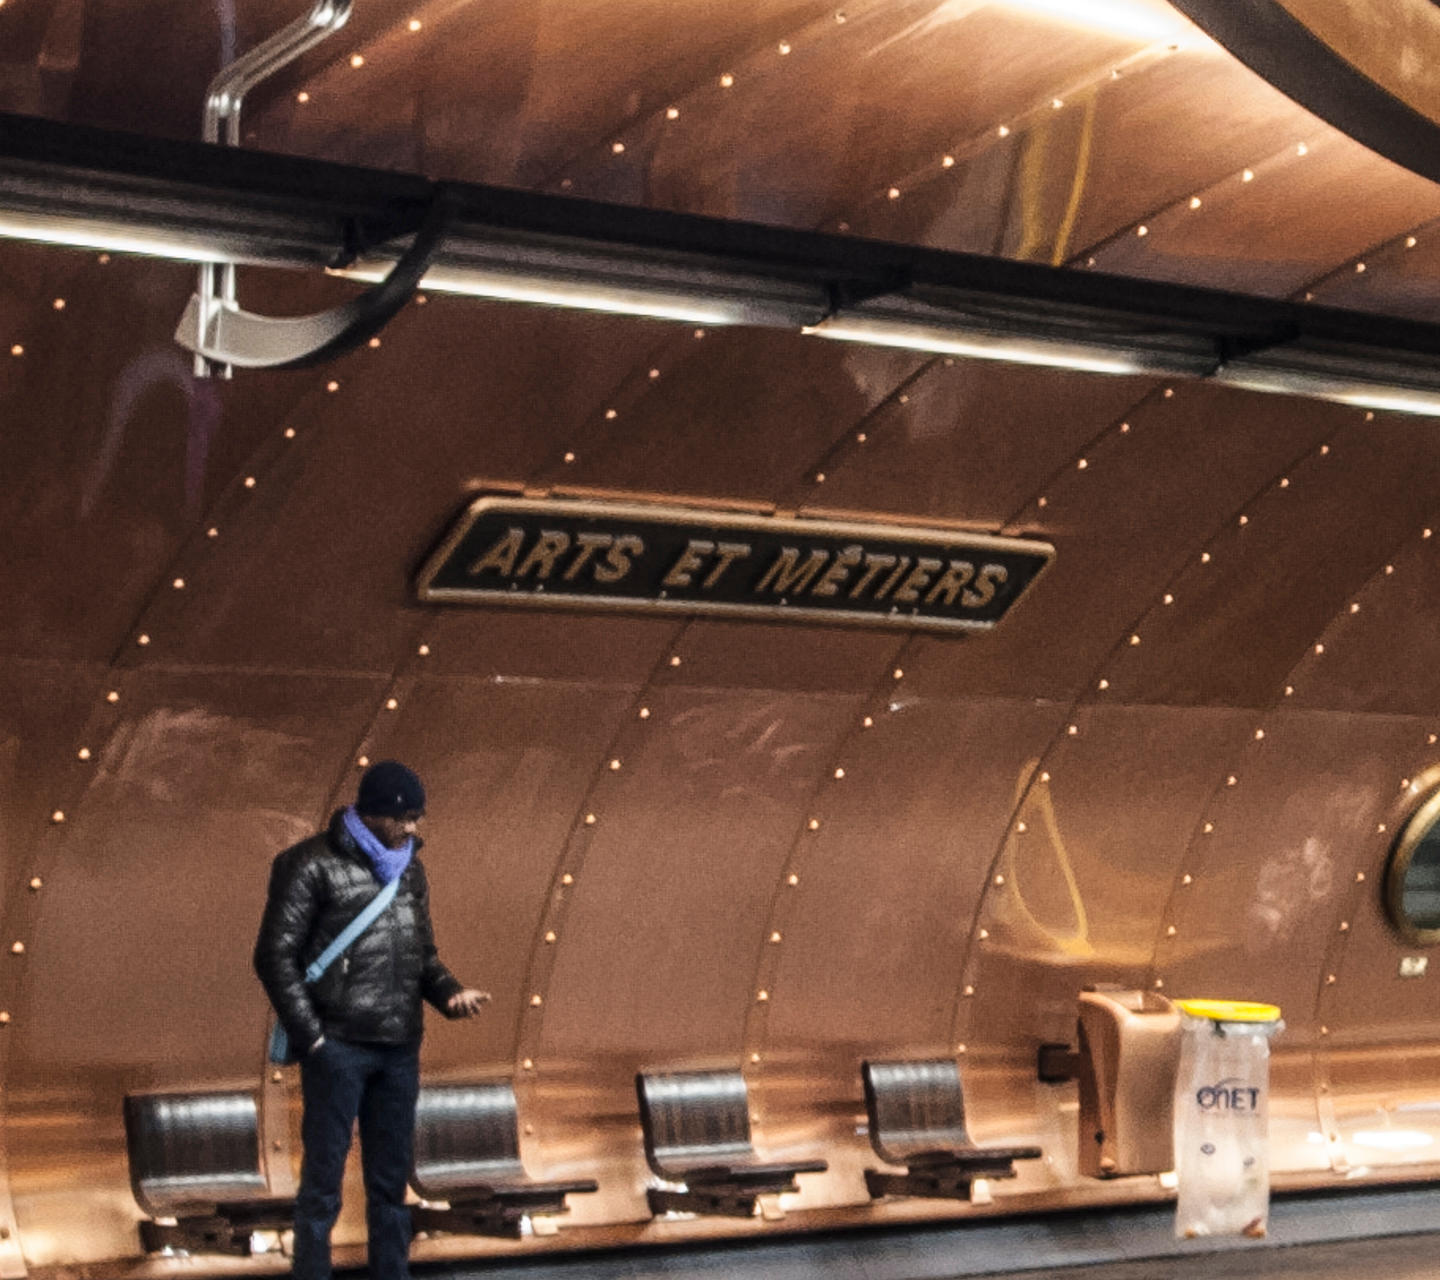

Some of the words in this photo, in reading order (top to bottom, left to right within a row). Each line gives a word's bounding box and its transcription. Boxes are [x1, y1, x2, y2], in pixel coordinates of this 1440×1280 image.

[469, 526, 644, 585] ARTS
[662, 540, 752, 590] ET
[754, 543, 1009, 609] MÉTIERS
